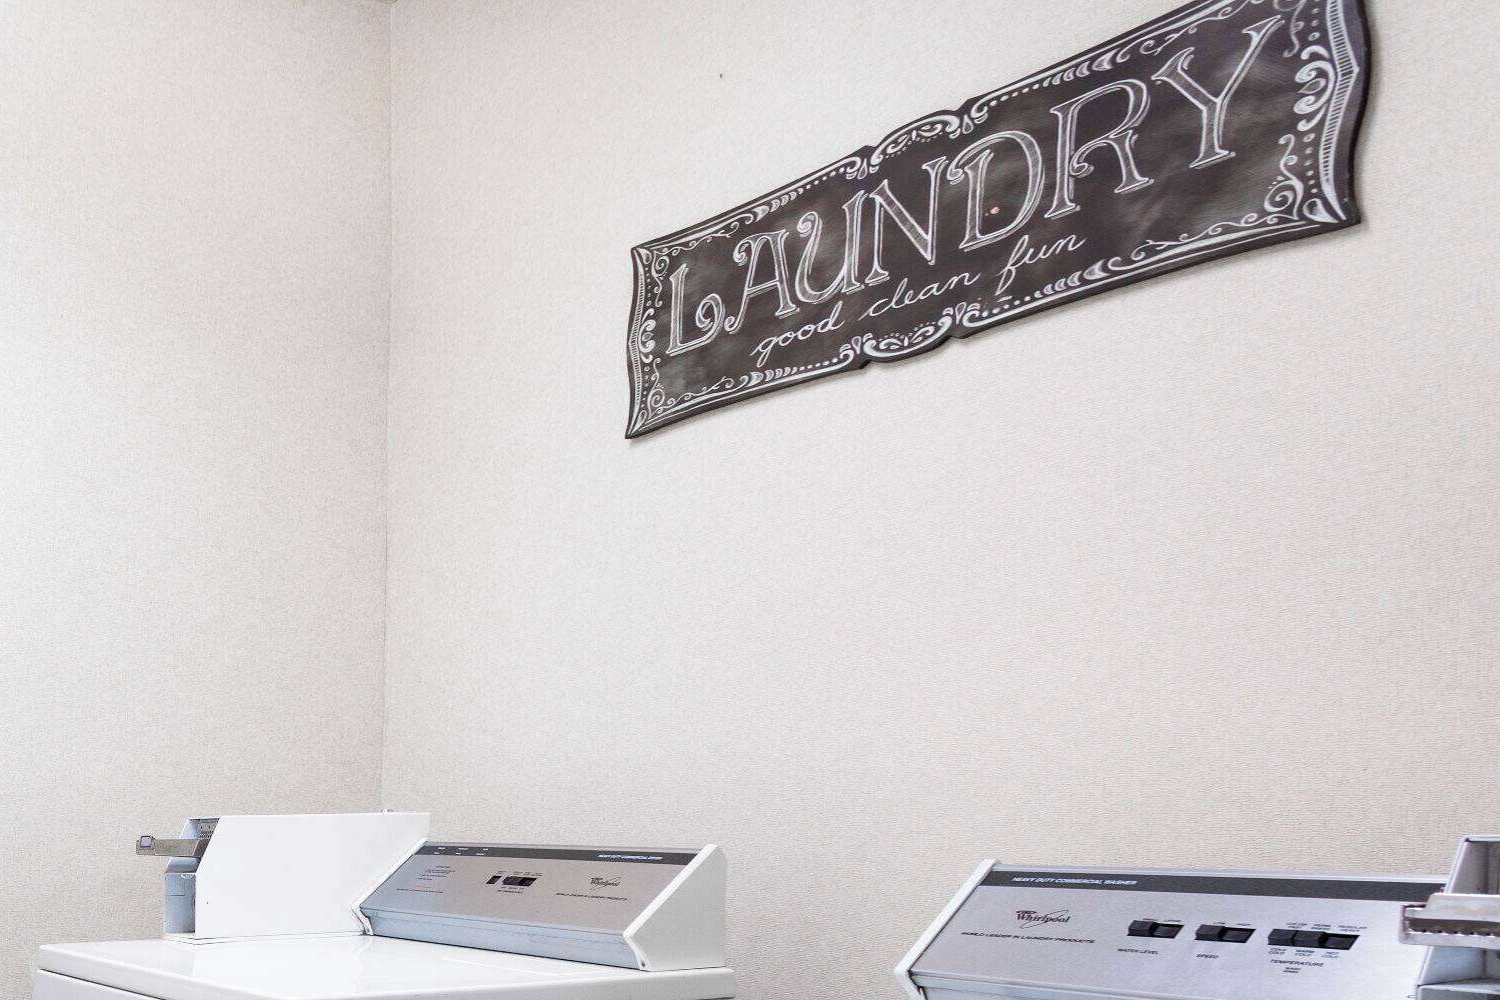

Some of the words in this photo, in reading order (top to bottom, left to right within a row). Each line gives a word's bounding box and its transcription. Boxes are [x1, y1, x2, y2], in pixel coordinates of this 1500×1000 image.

[665, 14, 1285, 356] LAUNDRY
[749, 300, 845, 368] good
[858, 270, 980, 322] clean
[996, 232, 1087, 295] fun
[1015, 909, 1072, 926] Whirlpool
